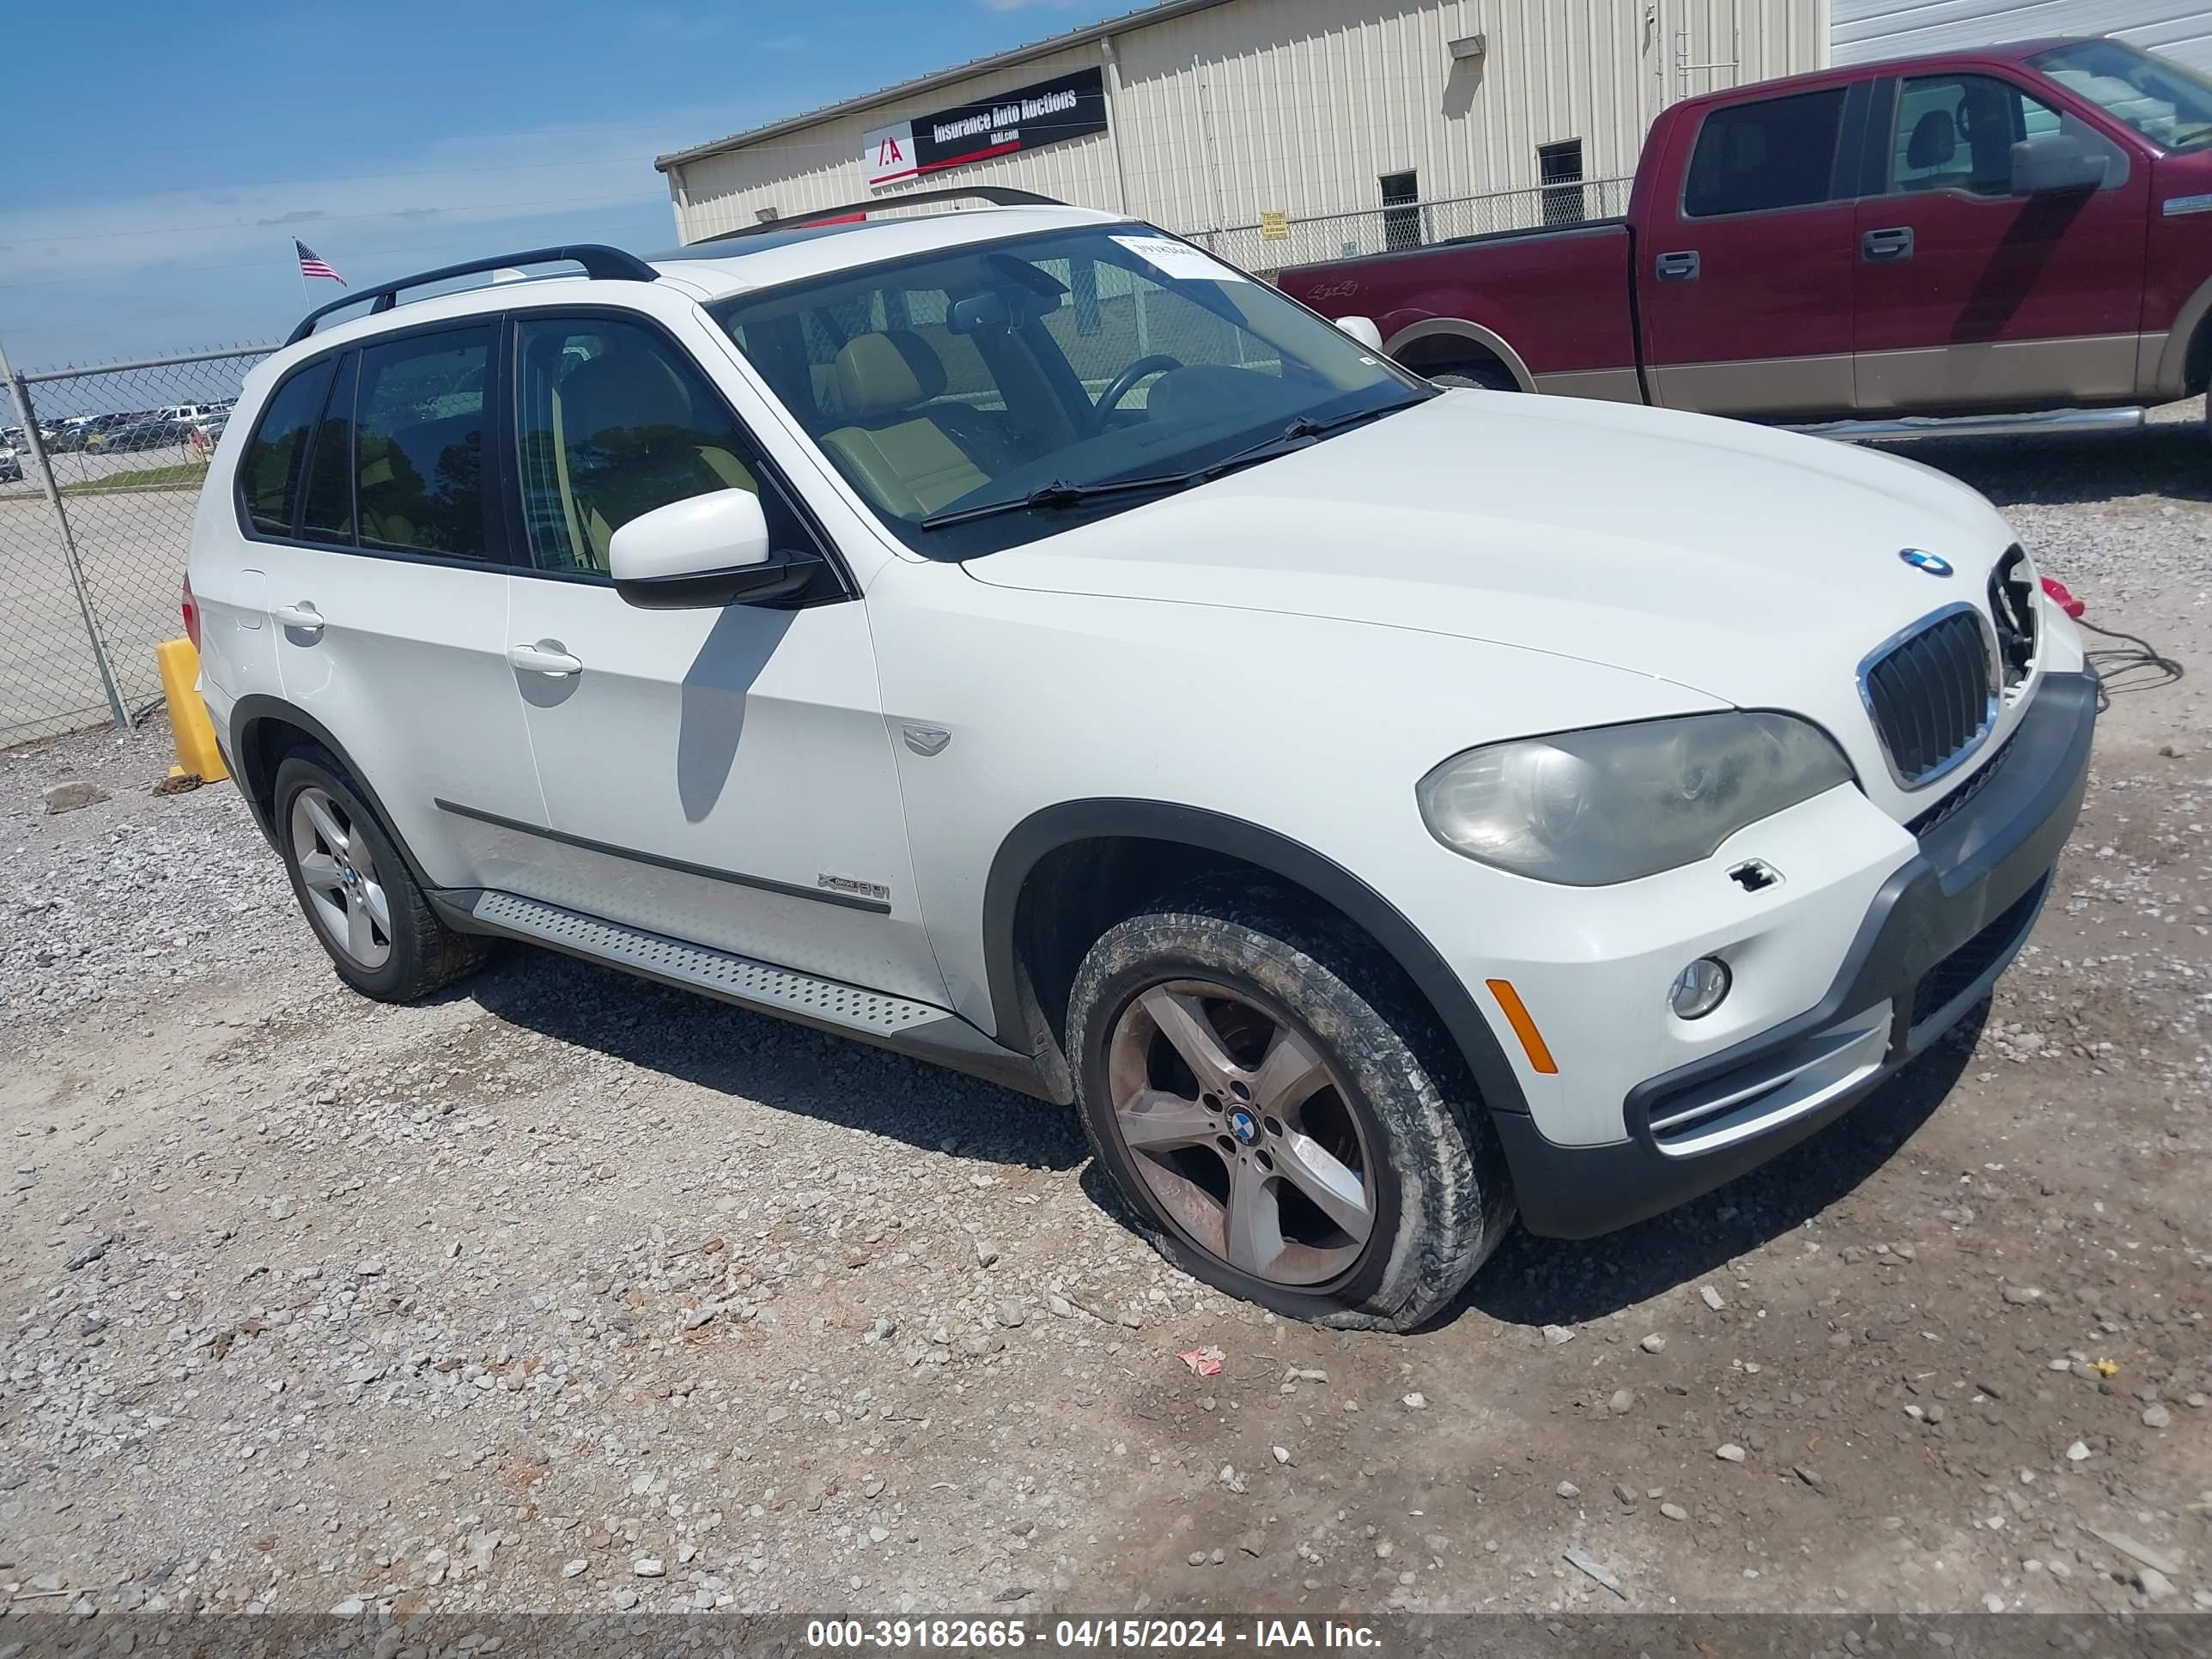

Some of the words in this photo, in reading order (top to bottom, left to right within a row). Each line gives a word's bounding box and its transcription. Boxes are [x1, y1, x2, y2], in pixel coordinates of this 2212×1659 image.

[933, 112, 992, 144] Insurance
[992, 105, 1021, 128] Auto
[1021, 89, 1078, 120] Auctions
[989, 129, 1020, 145] IAAI.com
